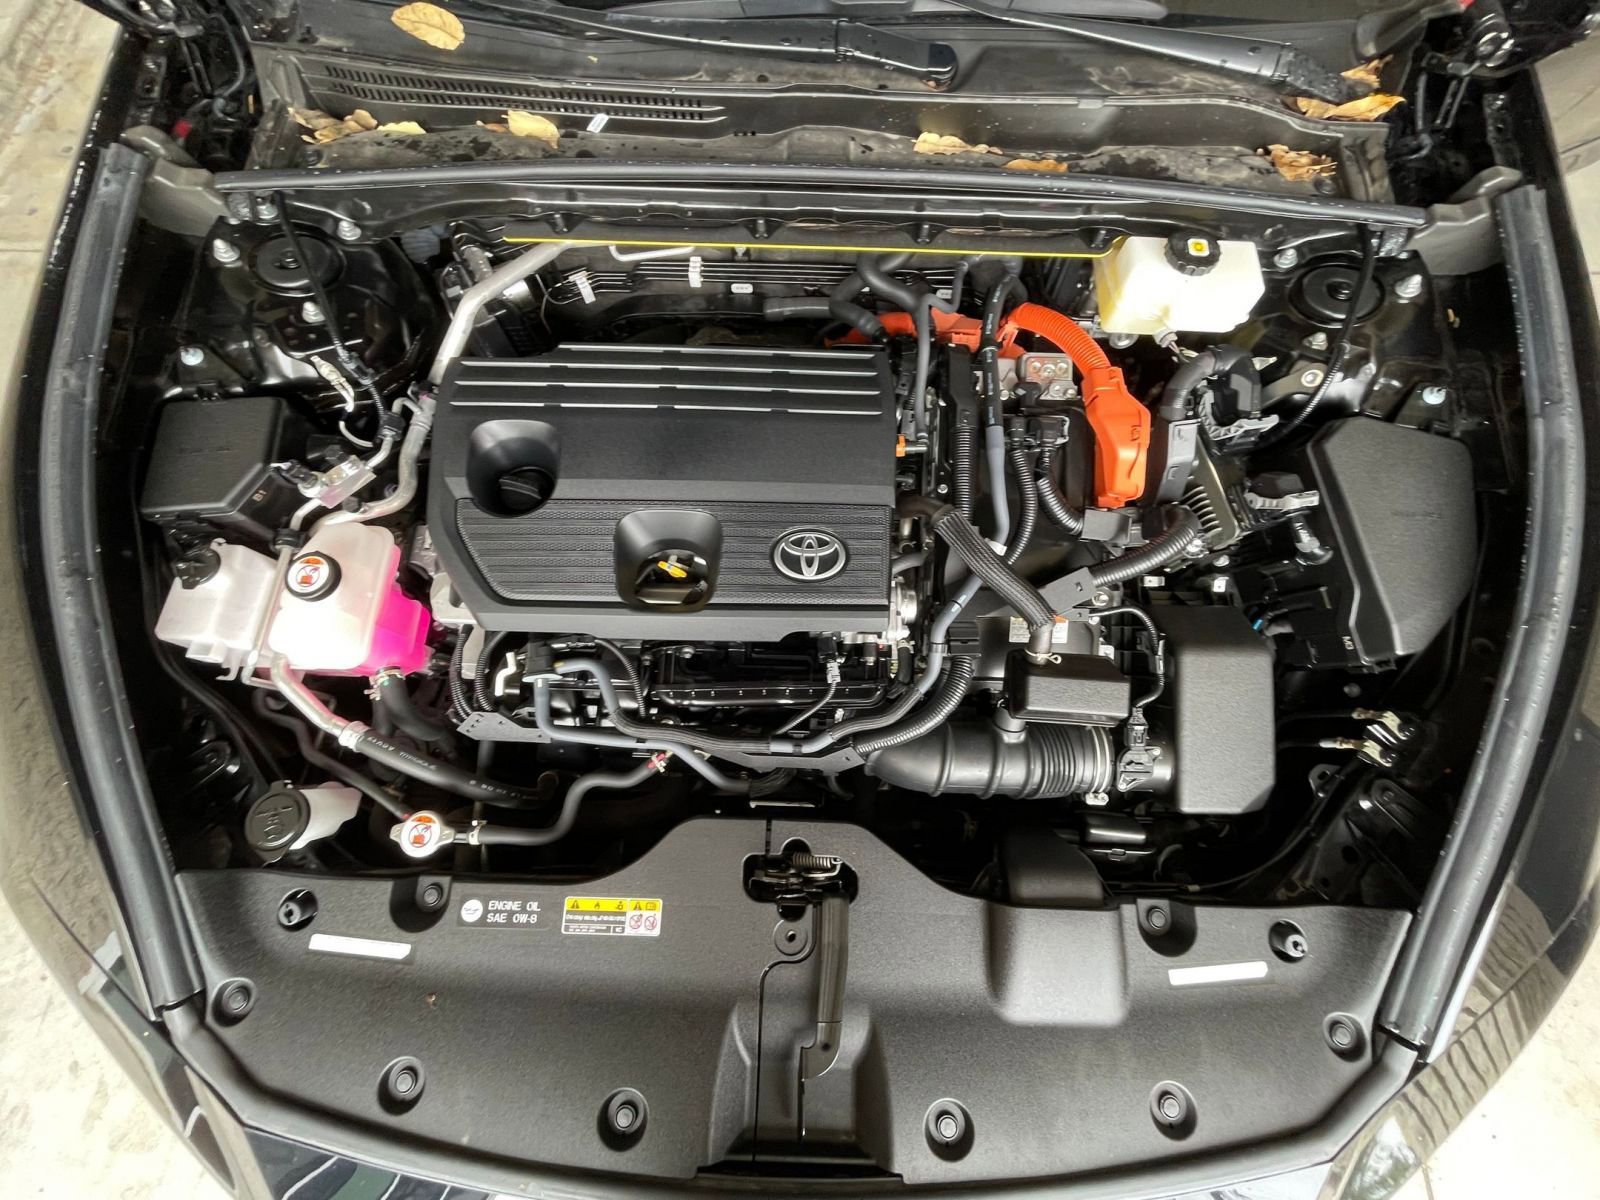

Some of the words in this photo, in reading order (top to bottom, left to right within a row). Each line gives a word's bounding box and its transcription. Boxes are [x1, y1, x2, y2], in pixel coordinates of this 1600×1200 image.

[488, 900, 522, 911] ENGINE
[526, 901, 541, 911] OIL
[486, 912, 508, 923] SAE
[512, 913, 538, 924] 0W-8
